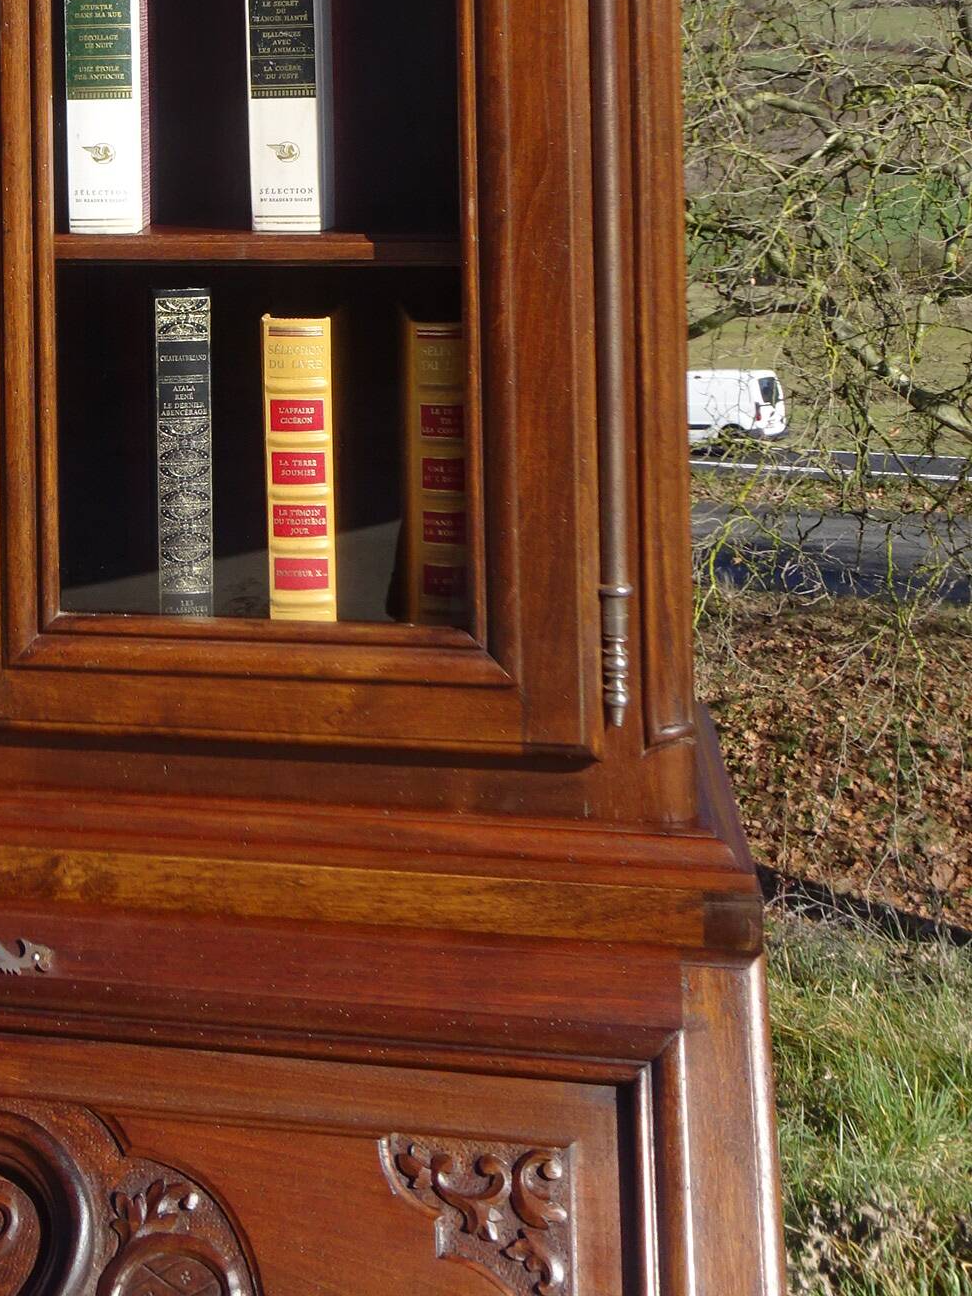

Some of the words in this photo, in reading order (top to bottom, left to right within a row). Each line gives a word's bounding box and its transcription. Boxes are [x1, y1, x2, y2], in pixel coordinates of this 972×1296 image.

[259, 187, 314, 195] SÉLECTION
[267, 343, 325, 355] SÉLECTION
[159, 353, 207, 362] CHATEAUBRIAND
[269, 360, 285, 369] DU
[292, 359, 324, 369] LIVRE
[174, 392, 194, 401] RENÉ
[174, 401, 205, 409] DERNIER
[161, 408, 208, 417] ABENCÉRAGE
[278, 406, 315, 415] L'AFFAIRE
[280, 415, 313, 424] CICÉRON
[292, 459, 317, 467] TERRE
[280, 468, 316, 477] SOUMISE
[290, 528, 310, 536] JOUR
[276, 569, 312, 577] DOCTEUR
